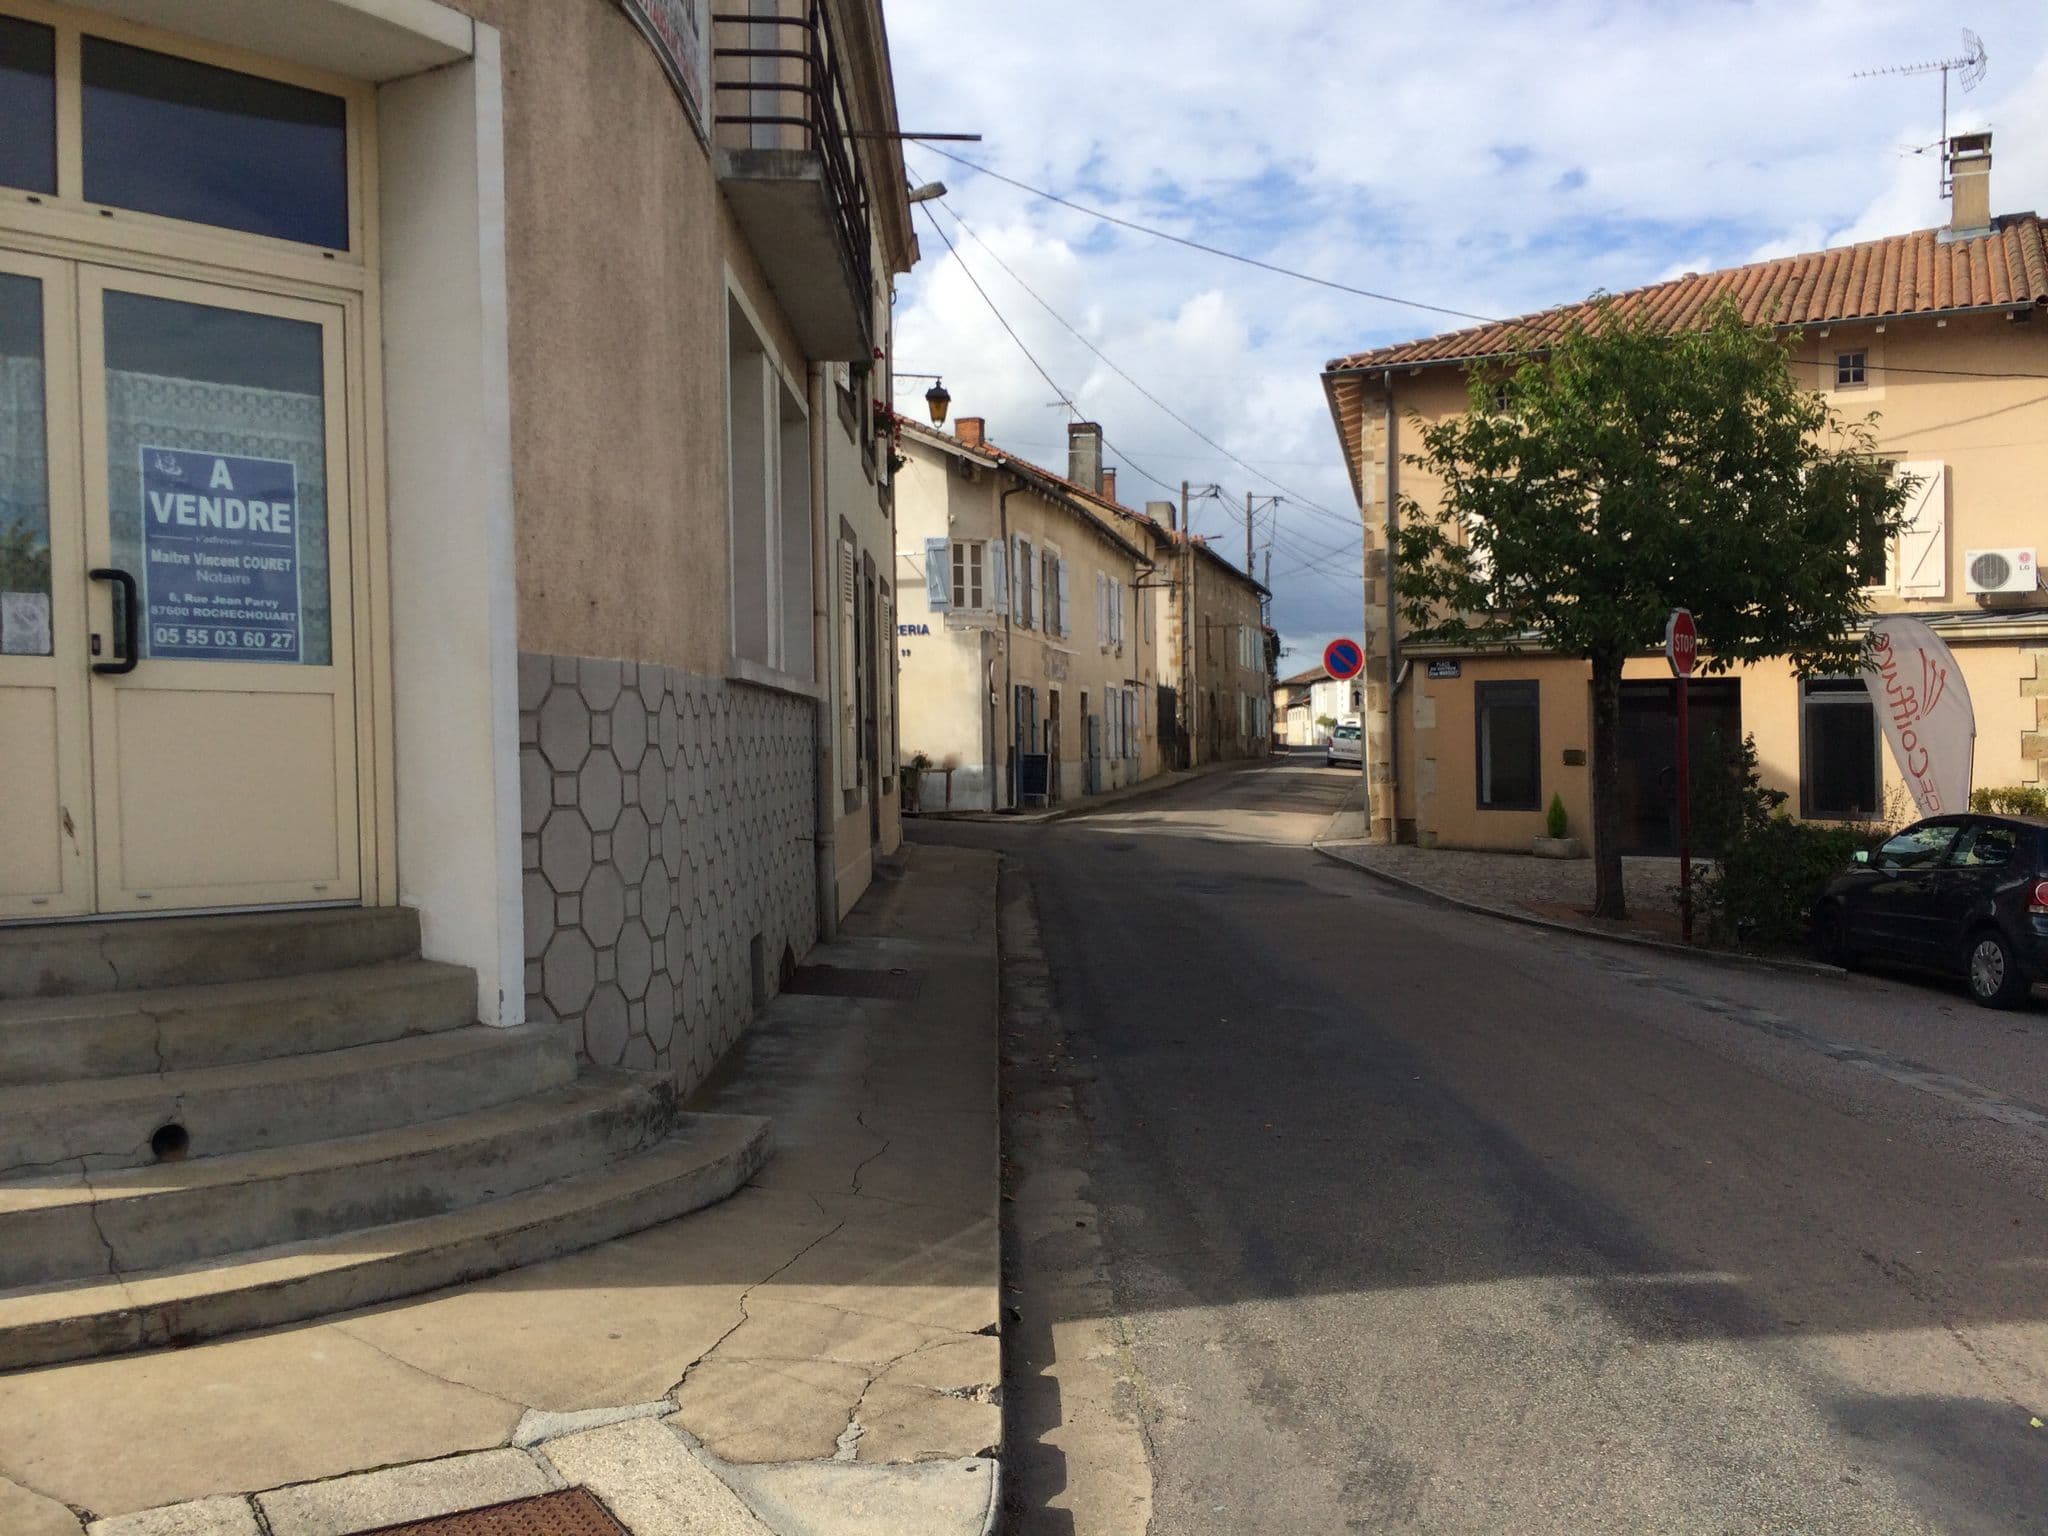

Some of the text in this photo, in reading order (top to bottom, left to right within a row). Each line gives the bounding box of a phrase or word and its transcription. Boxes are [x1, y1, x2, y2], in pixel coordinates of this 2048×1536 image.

[209, 458, 234, 491] A
[149, 490, 292, 534] VENDRE
[196, 569, 251, 585] Notaire
[184, 593, 208, 604] Rue
[193, 606, 296, 621] ROCHECHOUART
[156, 627, 293, 649] 05 55 03 60 27
[1675, 633, 1695, 653] STOP
